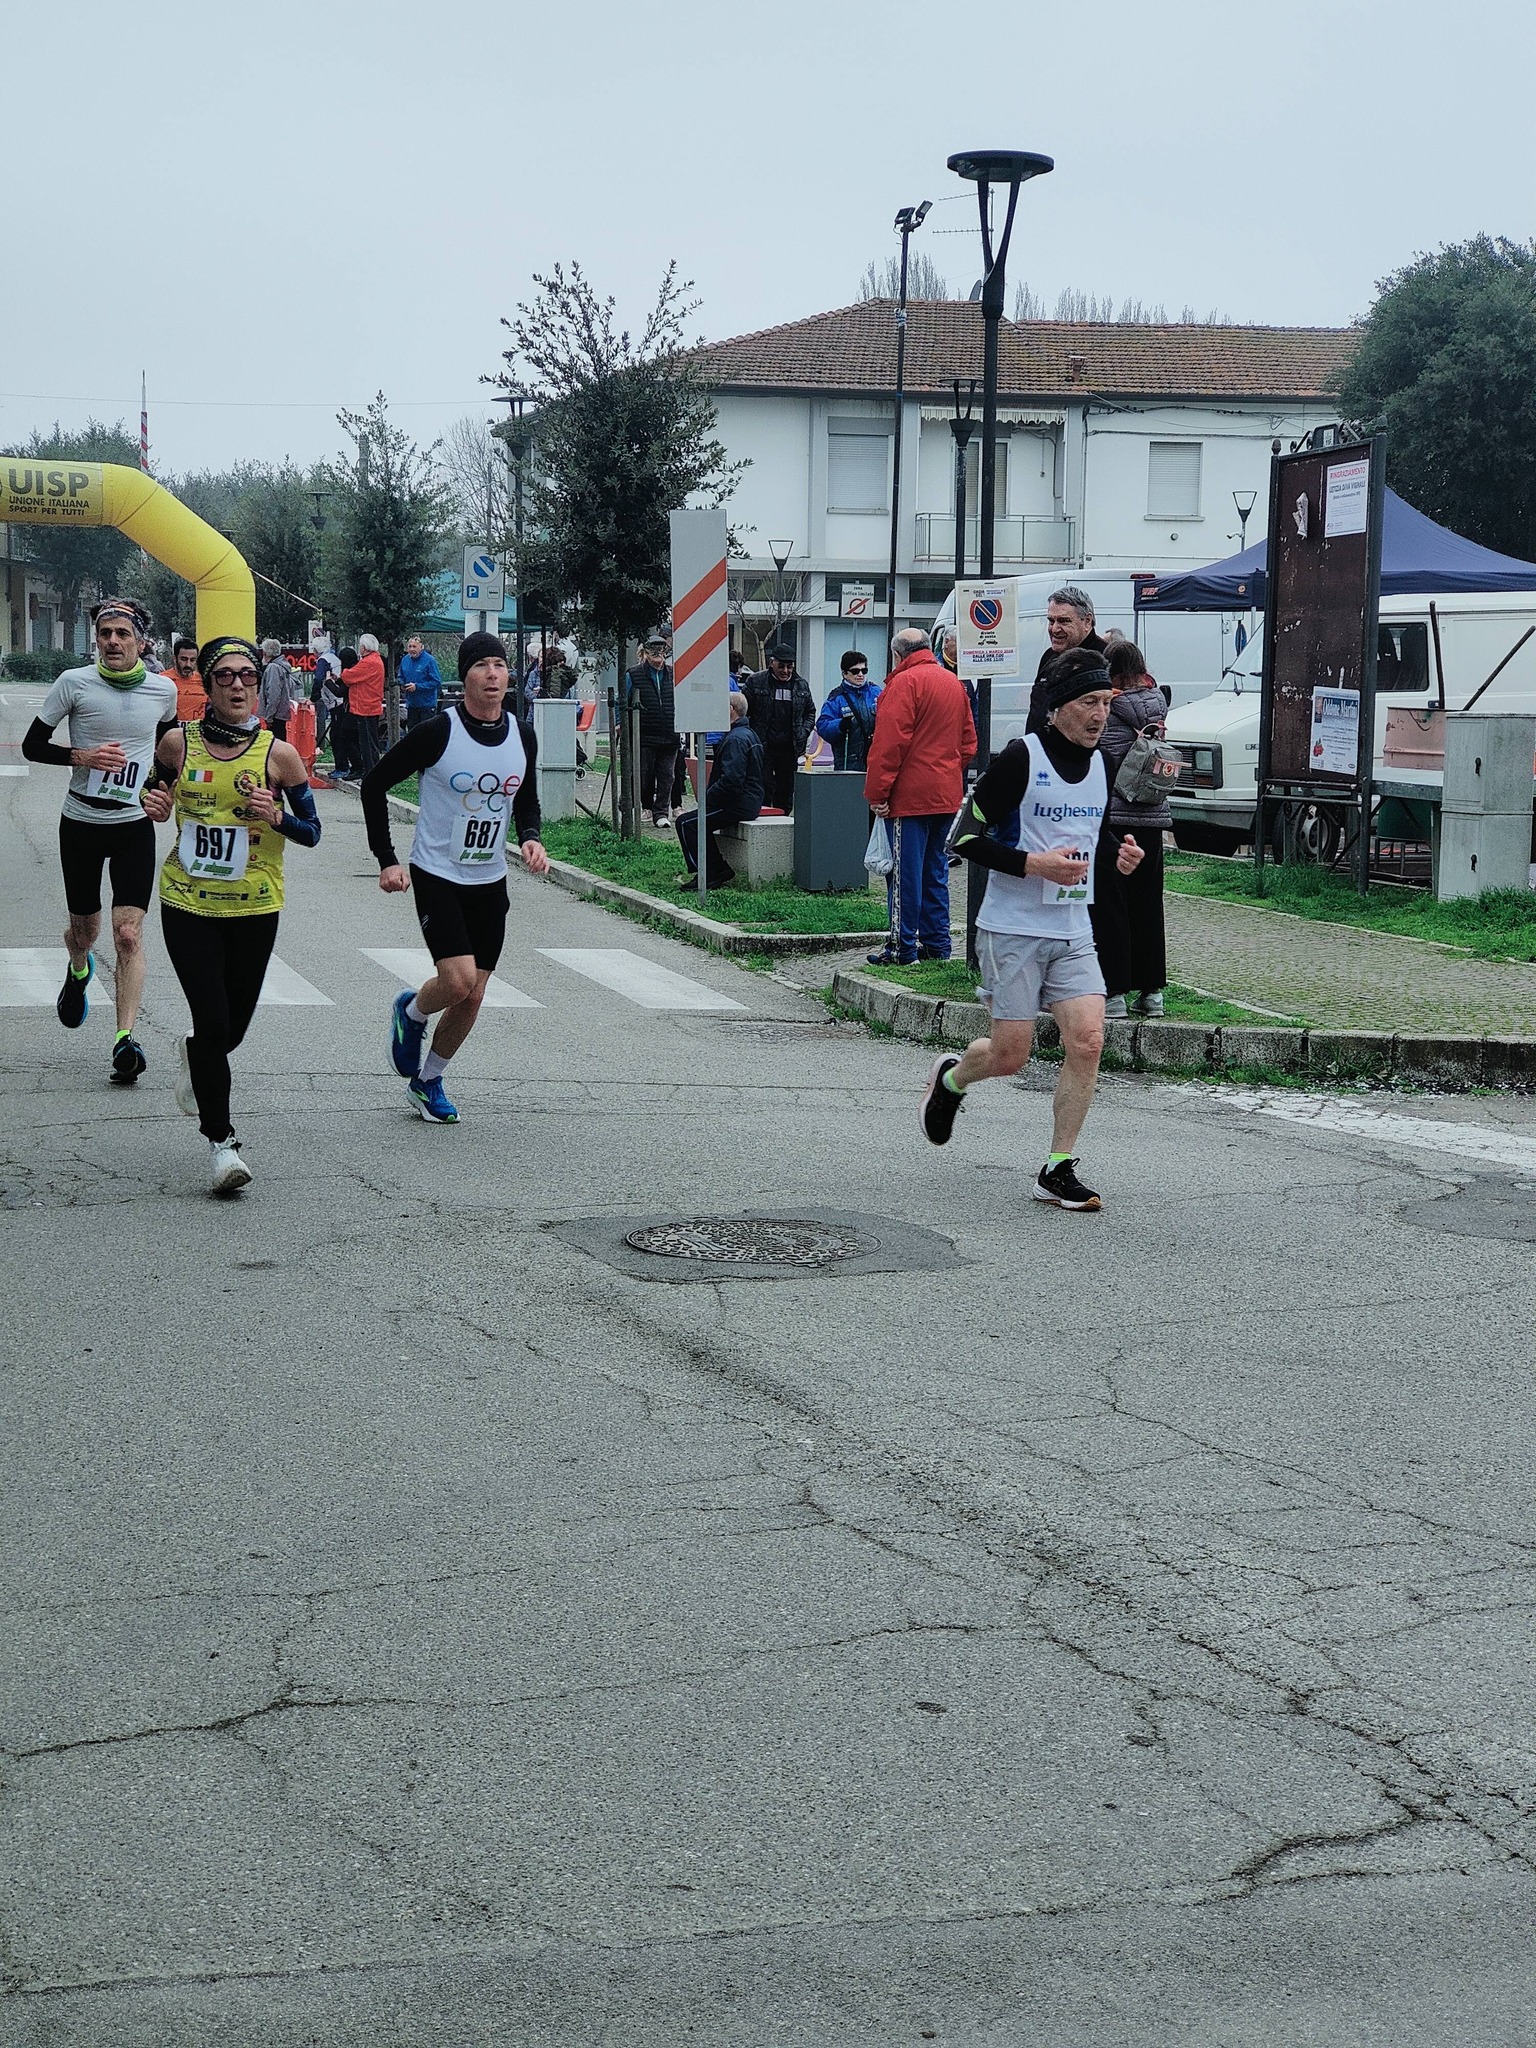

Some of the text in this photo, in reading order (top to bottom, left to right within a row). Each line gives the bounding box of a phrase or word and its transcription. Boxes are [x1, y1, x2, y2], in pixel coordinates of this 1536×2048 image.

[9, 468, 89, 498] UISP
[9, 496, 89, 509] UNIONE ITALIANA
[9, 506, 84, 516] SPORT PER TUTTI
[195, 825, 236, 861] 697
[464, 820, 501, 849] 687
